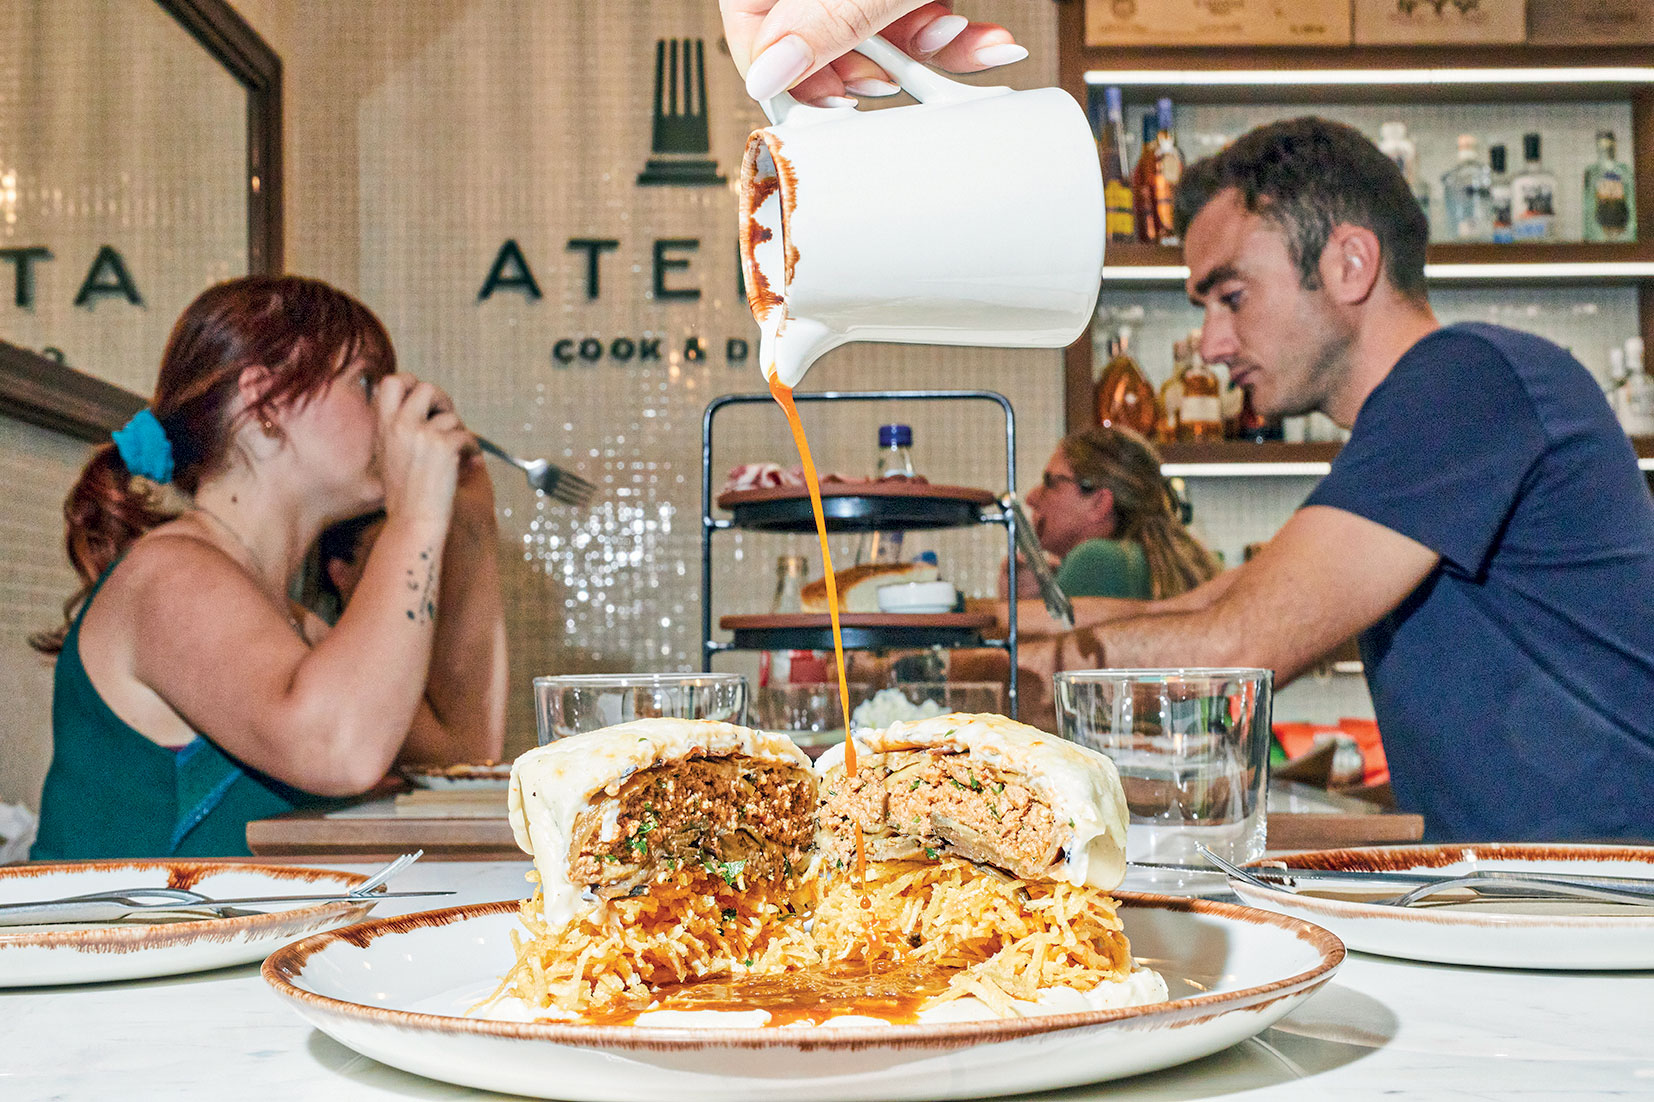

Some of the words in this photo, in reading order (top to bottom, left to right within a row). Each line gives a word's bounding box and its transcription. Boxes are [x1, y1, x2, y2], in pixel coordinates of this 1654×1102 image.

[477, 237, 746, 301] ATE
[552, 337, 661, 363] COOK
[683, 337, 706, 361] &
[726, 338, 761, 362] D
